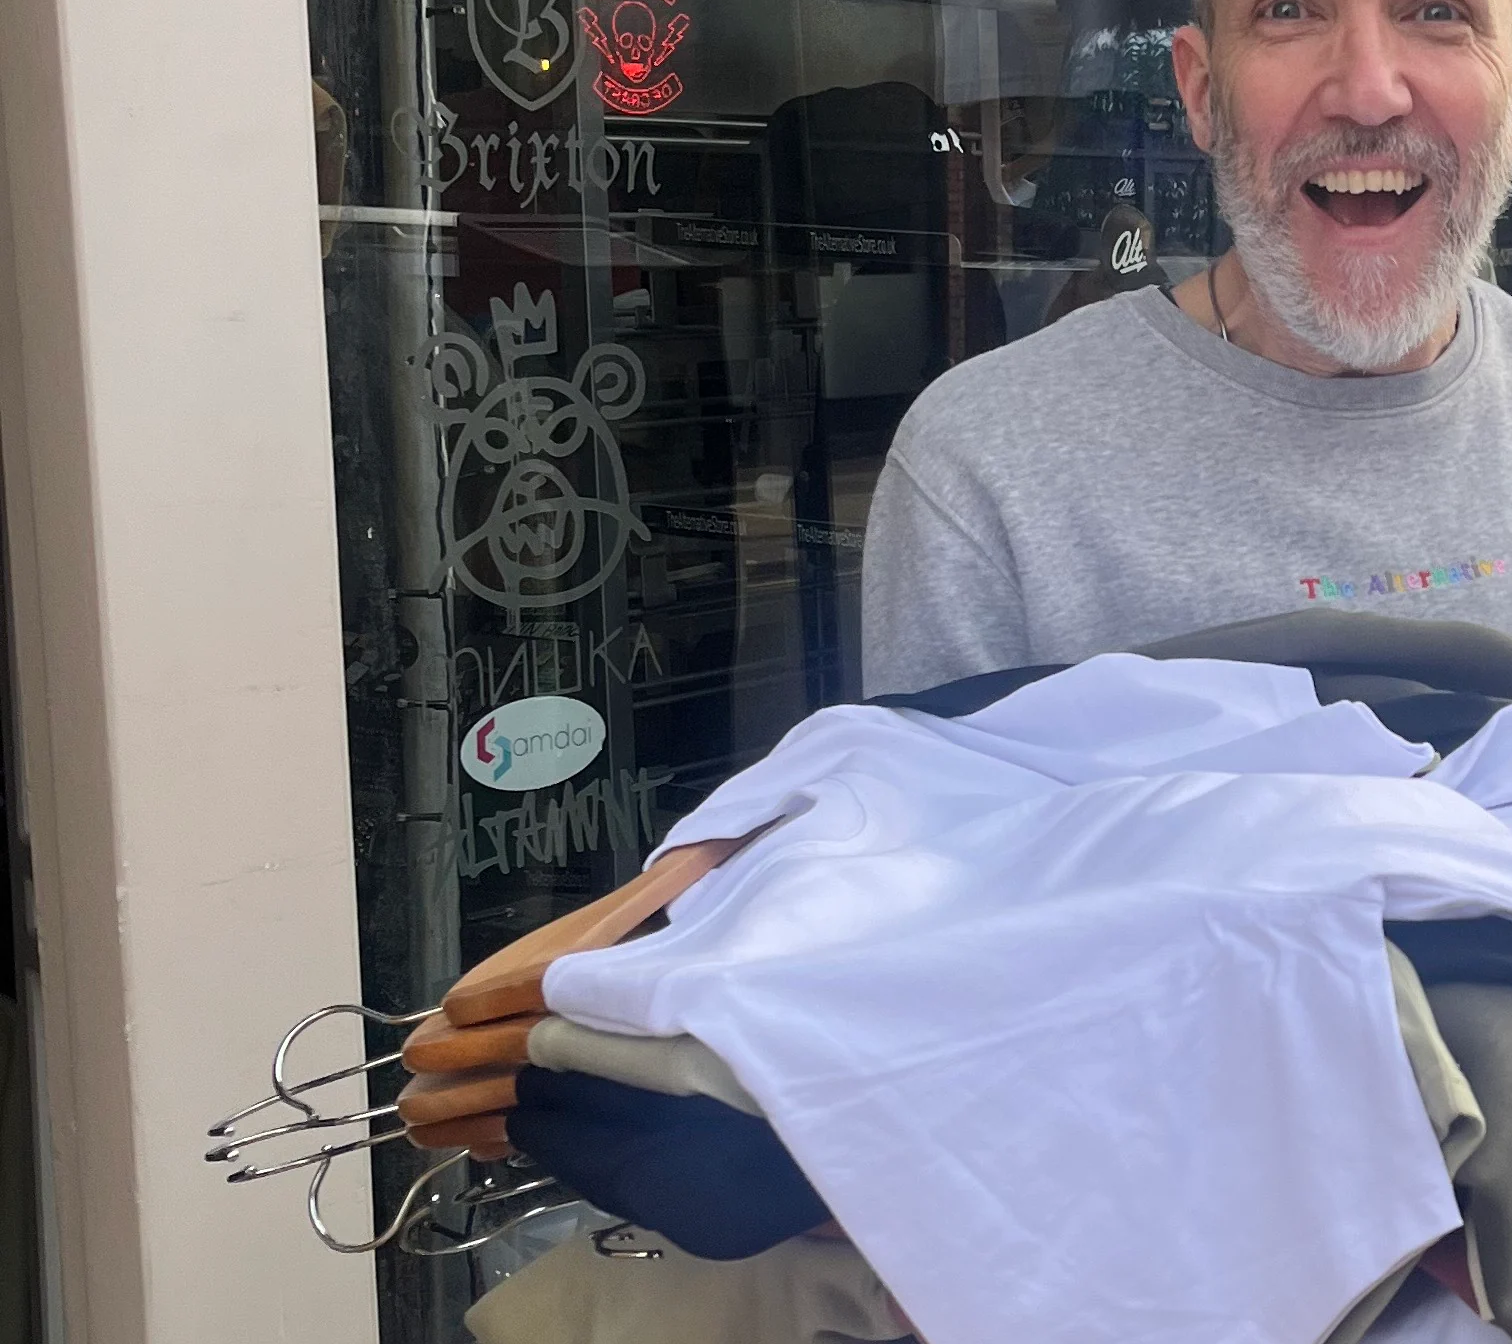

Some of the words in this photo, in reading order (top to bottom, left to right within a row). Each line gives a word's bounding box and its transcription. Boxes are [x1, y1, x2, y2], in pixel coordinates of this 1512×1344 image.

[390, 105, 662, 209] Brixton
[1300, 574, 1356, 601] The
[1367, 555, 1506, 596] Alternative
